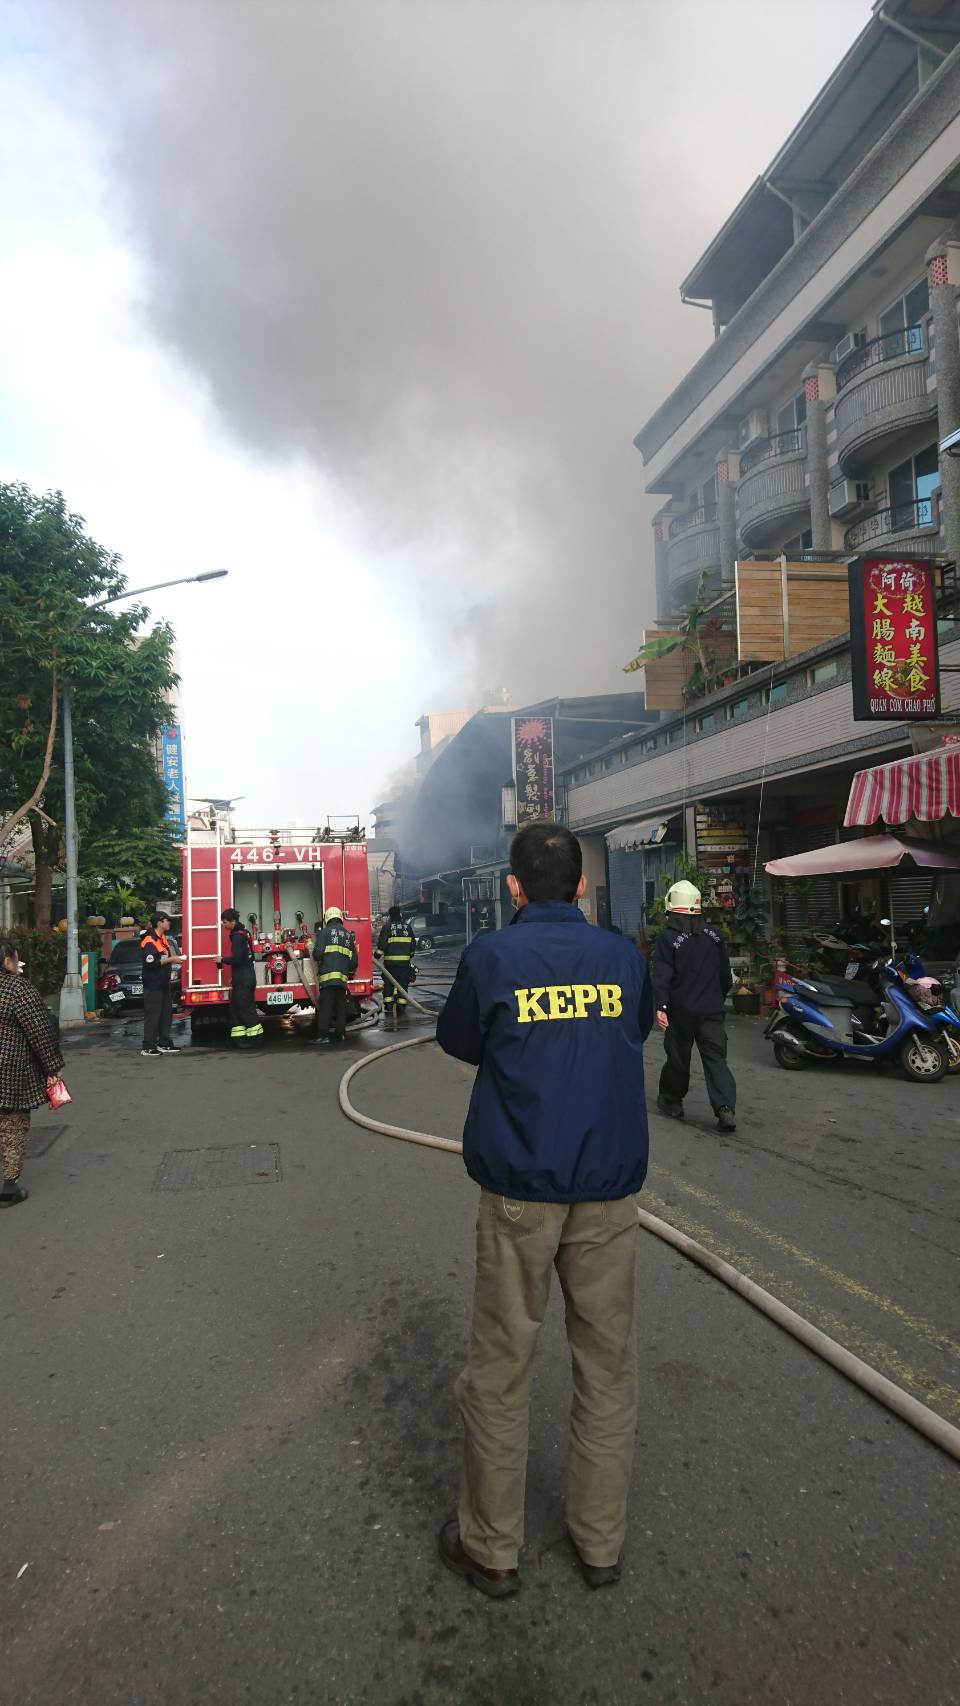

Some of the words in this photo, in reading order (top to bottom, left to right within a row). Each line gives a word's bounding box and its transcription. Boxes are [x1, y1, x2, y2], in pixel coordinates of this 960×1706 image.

[881, 571, 916, 592] 阿荷
[871, 593, 898, 692] 大腸麵線
[901, 592, 930, 692] 越南美食
[514, 984, 623, 1023] KEPB
